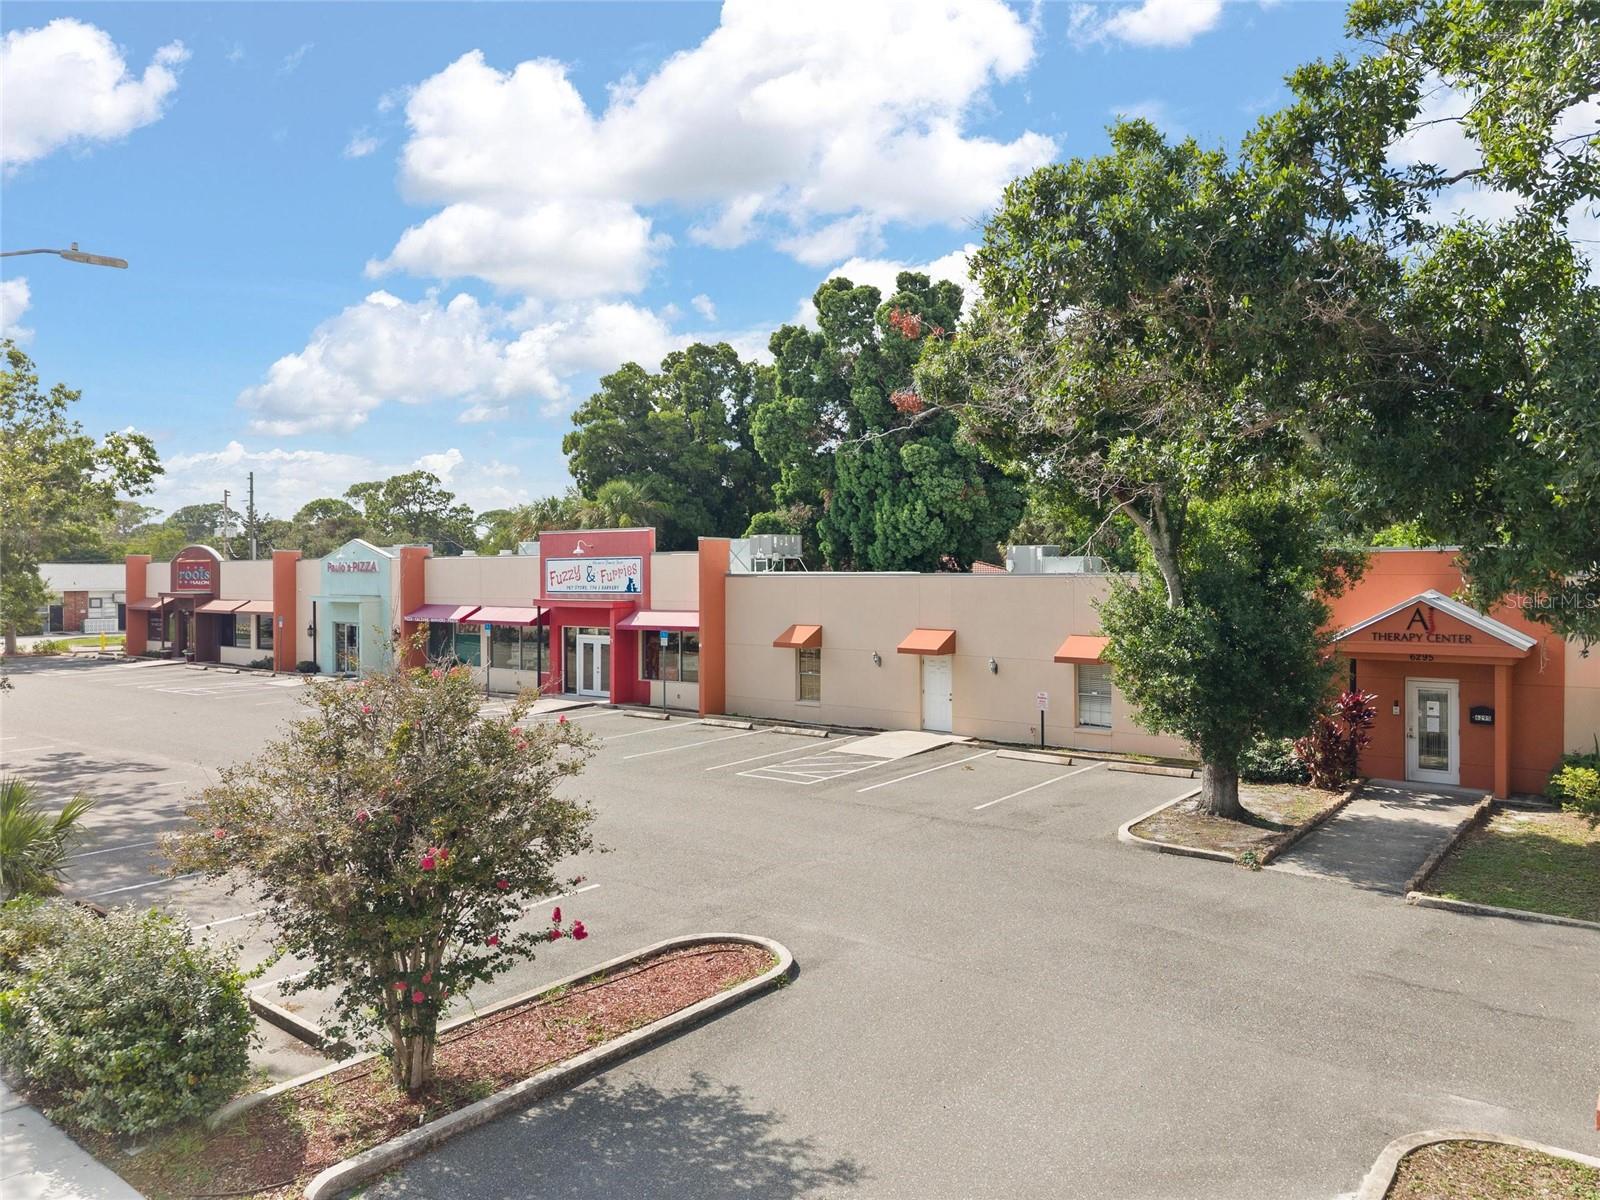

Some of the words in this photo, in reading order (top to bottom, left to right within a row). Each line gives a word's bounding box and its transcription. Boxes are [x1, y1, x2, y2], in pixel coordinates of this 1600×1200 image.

[352, 560, 378, 573] PIZZA
[178, 567, 210, 580] roots
[549, 564, 581, 587] Fuzzy
[586, 565, 596, 583] &
[1371, 632, 1423, 642] THERAPY
[1426, 633, 1473, 644] CENTER
[1409, 653, 1435, 661] 6295
